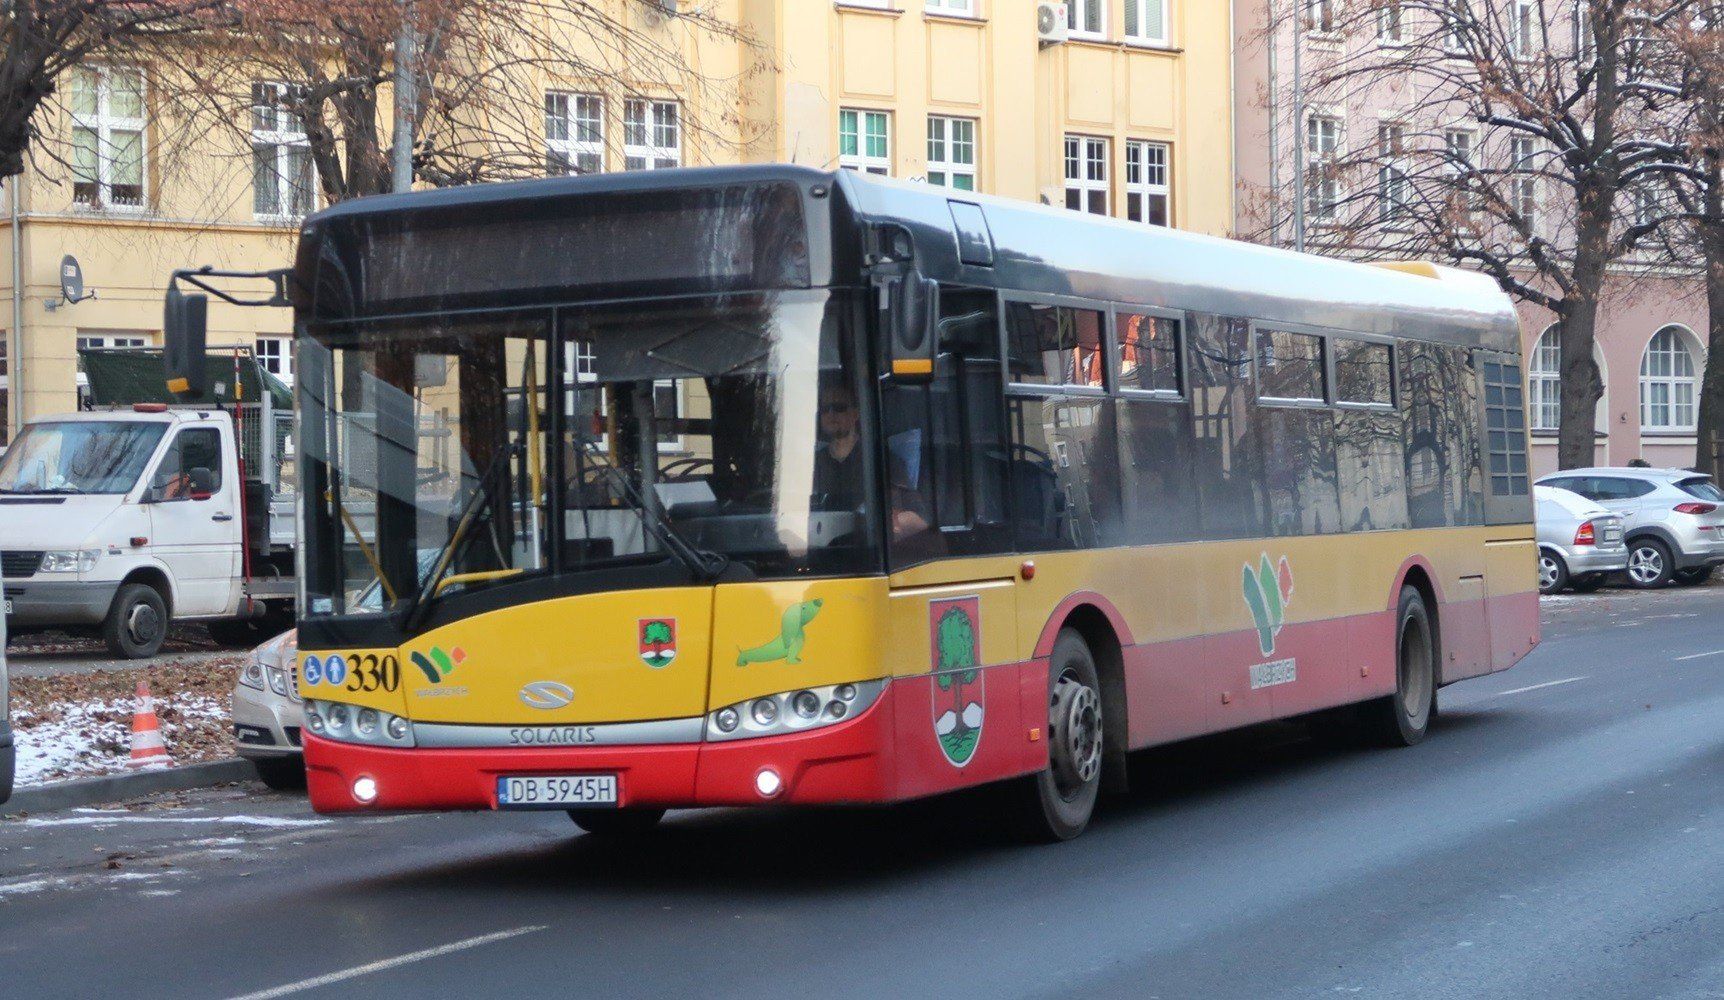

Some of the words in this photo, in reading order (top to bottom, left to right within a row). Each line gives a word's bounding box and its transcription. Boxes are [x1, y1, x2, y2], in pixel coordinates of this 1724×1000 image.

[346, 654, 400, 692] 330
[510, 727, 596, 744] SOLARIS
[512, 780, 538, 801] DB
[546, 779, 611, 801] 5945H
